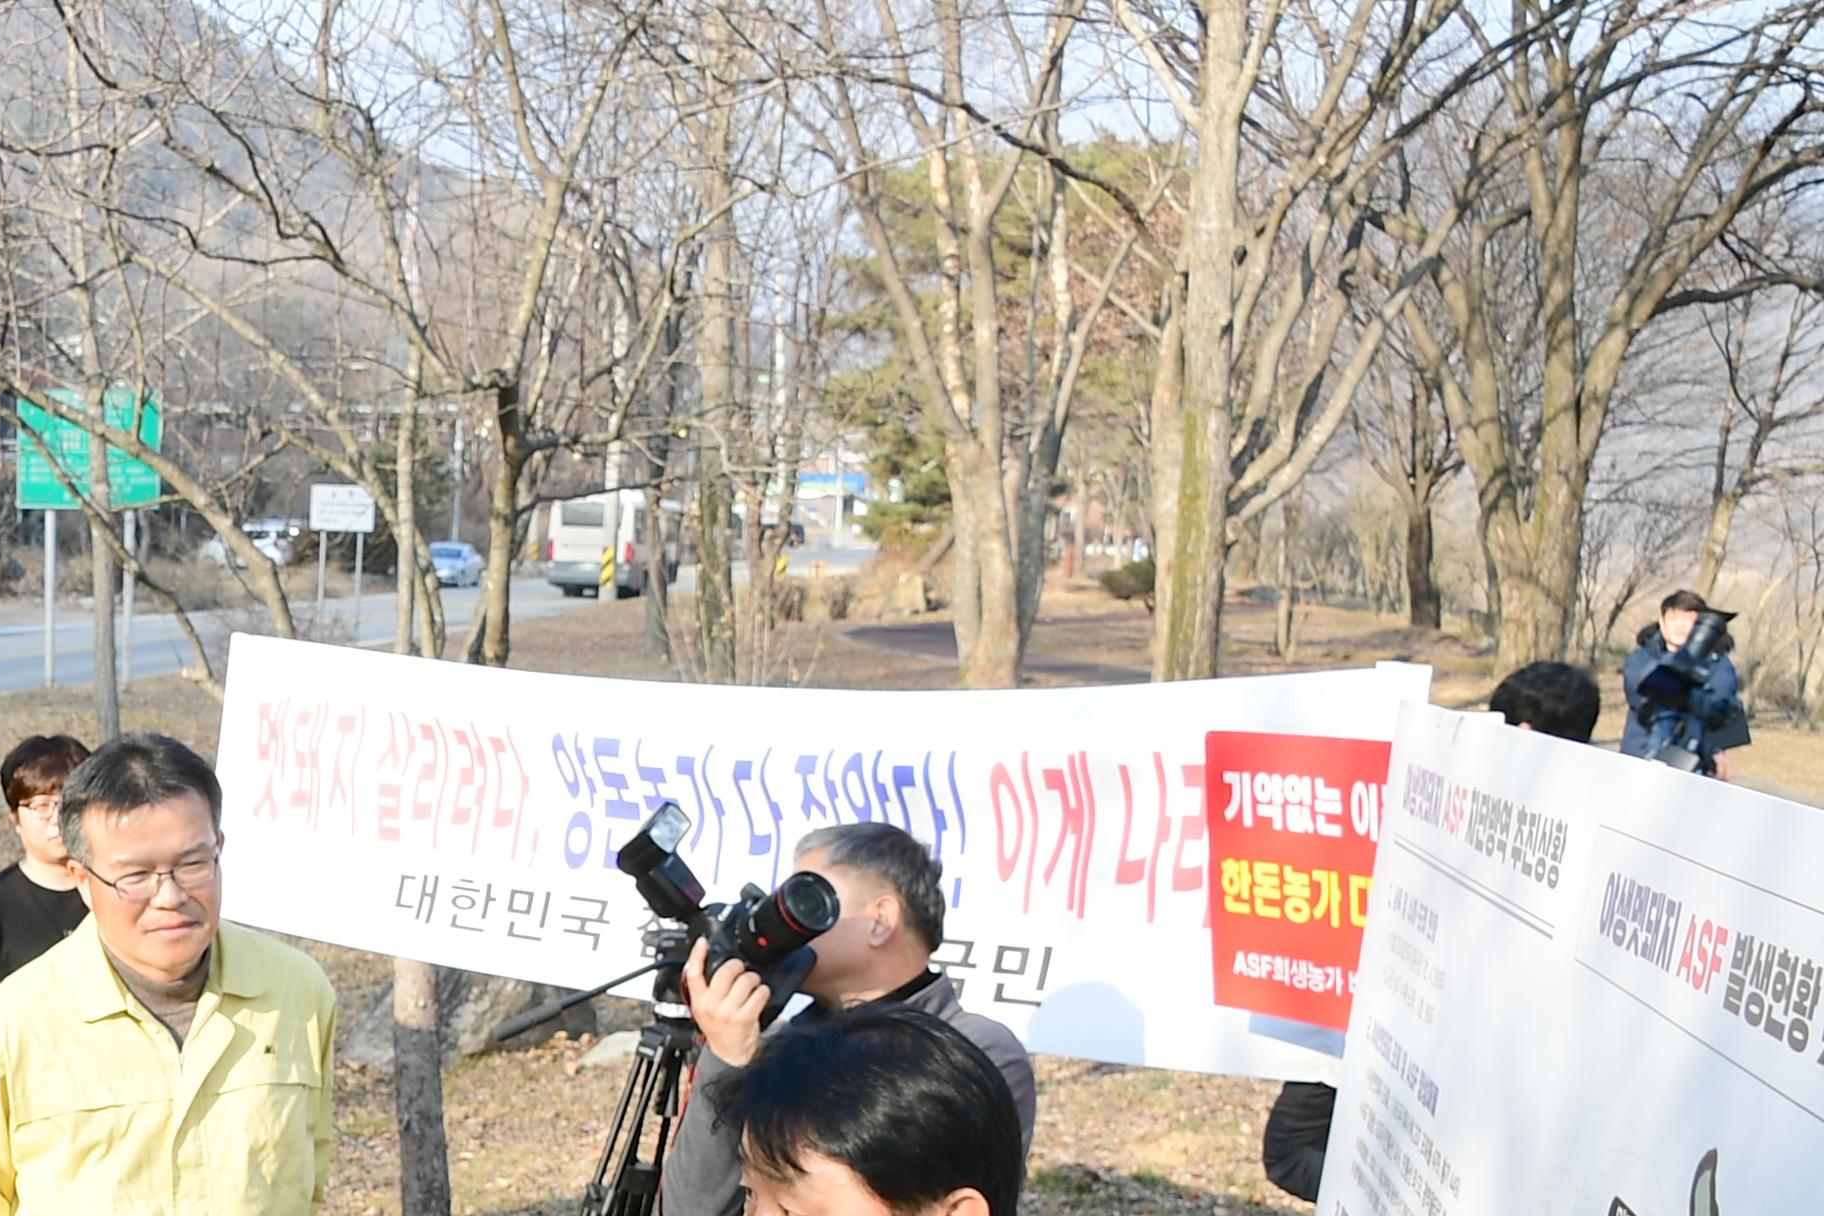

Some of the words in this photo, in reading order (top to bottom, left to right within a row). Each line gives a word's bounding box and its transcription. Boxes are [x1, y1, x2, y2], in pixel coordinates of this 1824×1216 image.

[254, 700, 365, 836] 멧돼지
[377, 711, 542, 868] 살리려다,
[989, 750, 1096, 919] 이게
[1441, 781, 1468, 838] ASF
[1510, 804, 1569, 890] 추진상황
[394, 873, 611, 951] 대한민국
[1220, 858, 1341, 929] 한돈농가
[1232, 950, 1343, 997] ASF희생농가
[1599, 871, 1683, 973] 야생멧돼지
[1675, 913, 1730, 995] ASF
[1722, 931, 1824, 1054] 발생현황
